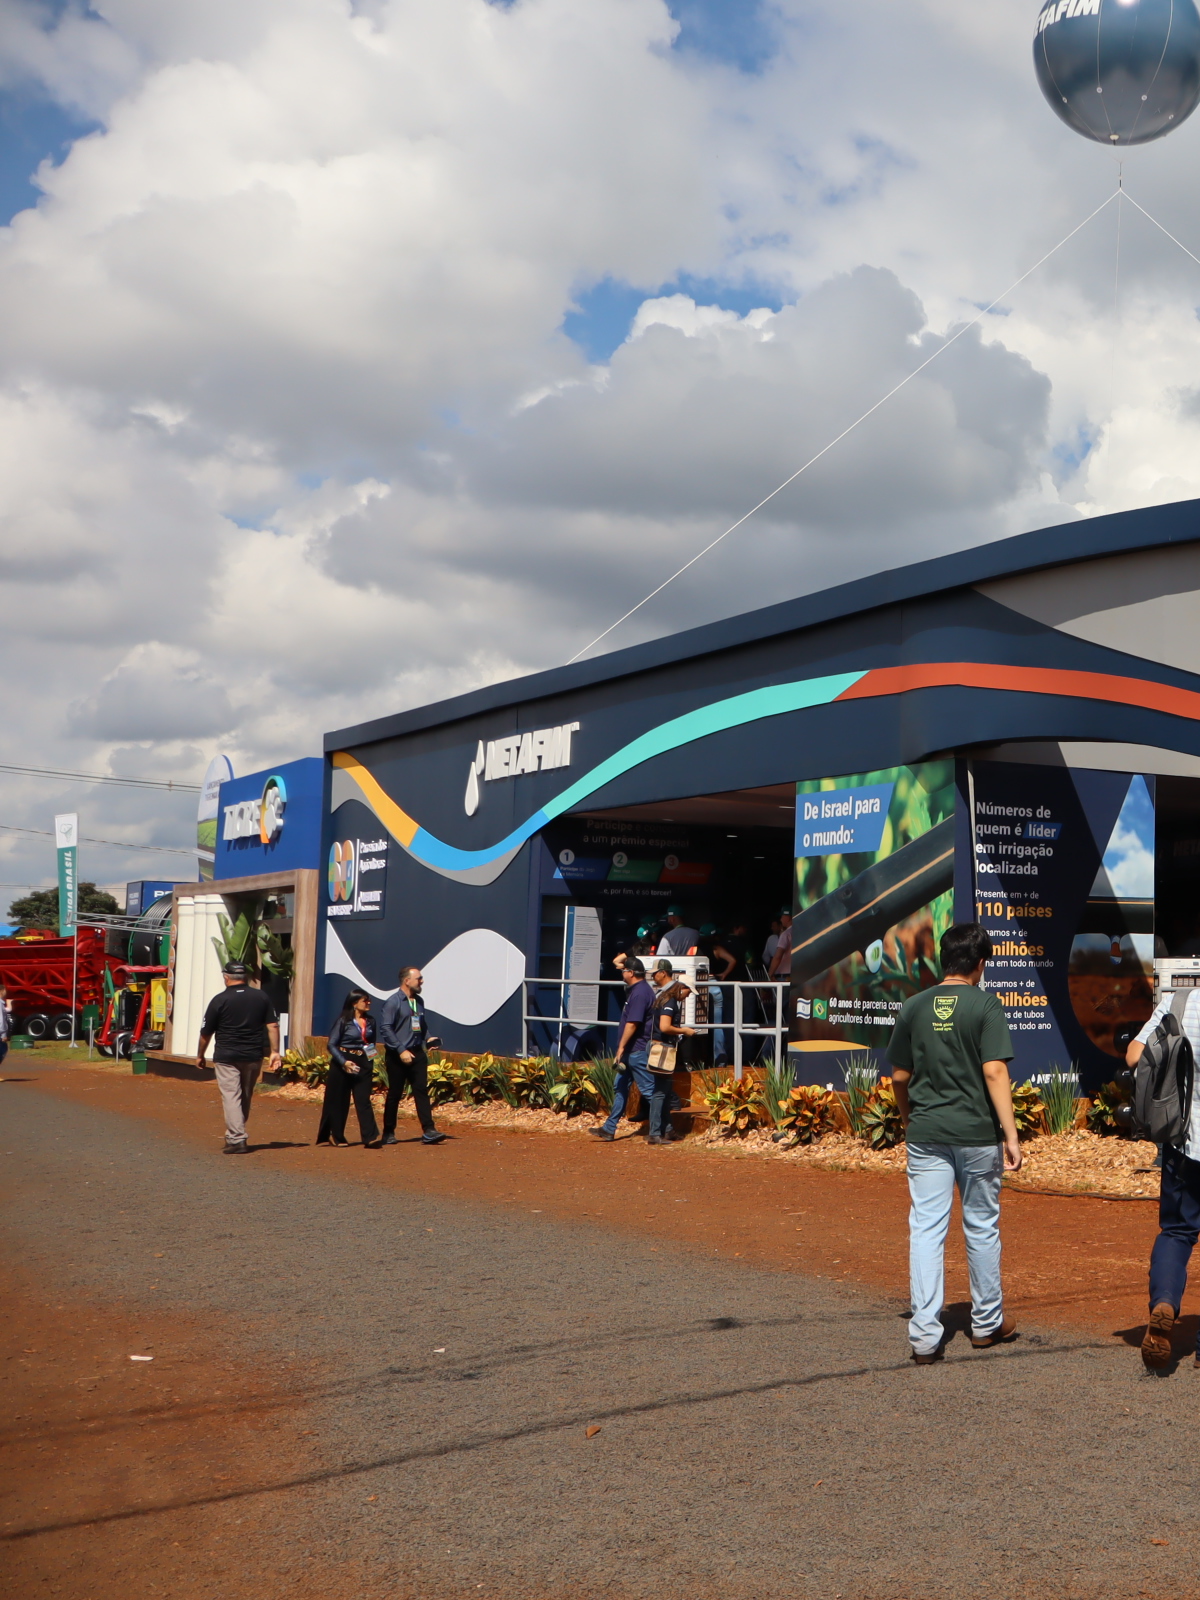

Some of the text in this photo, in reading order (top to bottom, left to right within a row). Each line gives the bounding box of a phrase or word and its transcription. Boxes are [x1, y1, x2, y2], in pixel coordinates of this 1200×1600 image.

[804, 795, 880, 820] De Israel para
[976, 801, 1051, 818] Números de
[976, 822, 1056, 838] quem é líder
[592, 836, 608, 844] um
[610, 836, 646, 846] prêmio
[803, 824, 854, 848] o mundo:
[976, 842, 1054, 859] em irrigação
[564, 852, 570, 862] 1
[616, 854, 624, 864] 2
[668, 857, 675, 867] 3
[976, 859, 1038, 875] localizada
[976, 889, 1008, 898] Presente
[1030, 890, 1039, 900] de
[976, 902, 1052, 920] 110 países
[1018, 929, 1028, 937] de
[996, 960, 1008, 968] em
[1010, 959, 1027, 968] todo
[1028, 960, 1054, 968] mundo
[977, 980, 1018, 988] abricamos
[1026, 980, 1036, 988] de
[829, 997, 902, 1012] 60 anos de parceria com
[828, 1012, 896, 1026] agricultores do mundo
[1012, 1010, 1022, 1019] de
[1024, 1010, 1044, 1019] tubos
[1019, 1022, 1036, 1030] todo
[1038, 1022, 1052, 1030] ano
